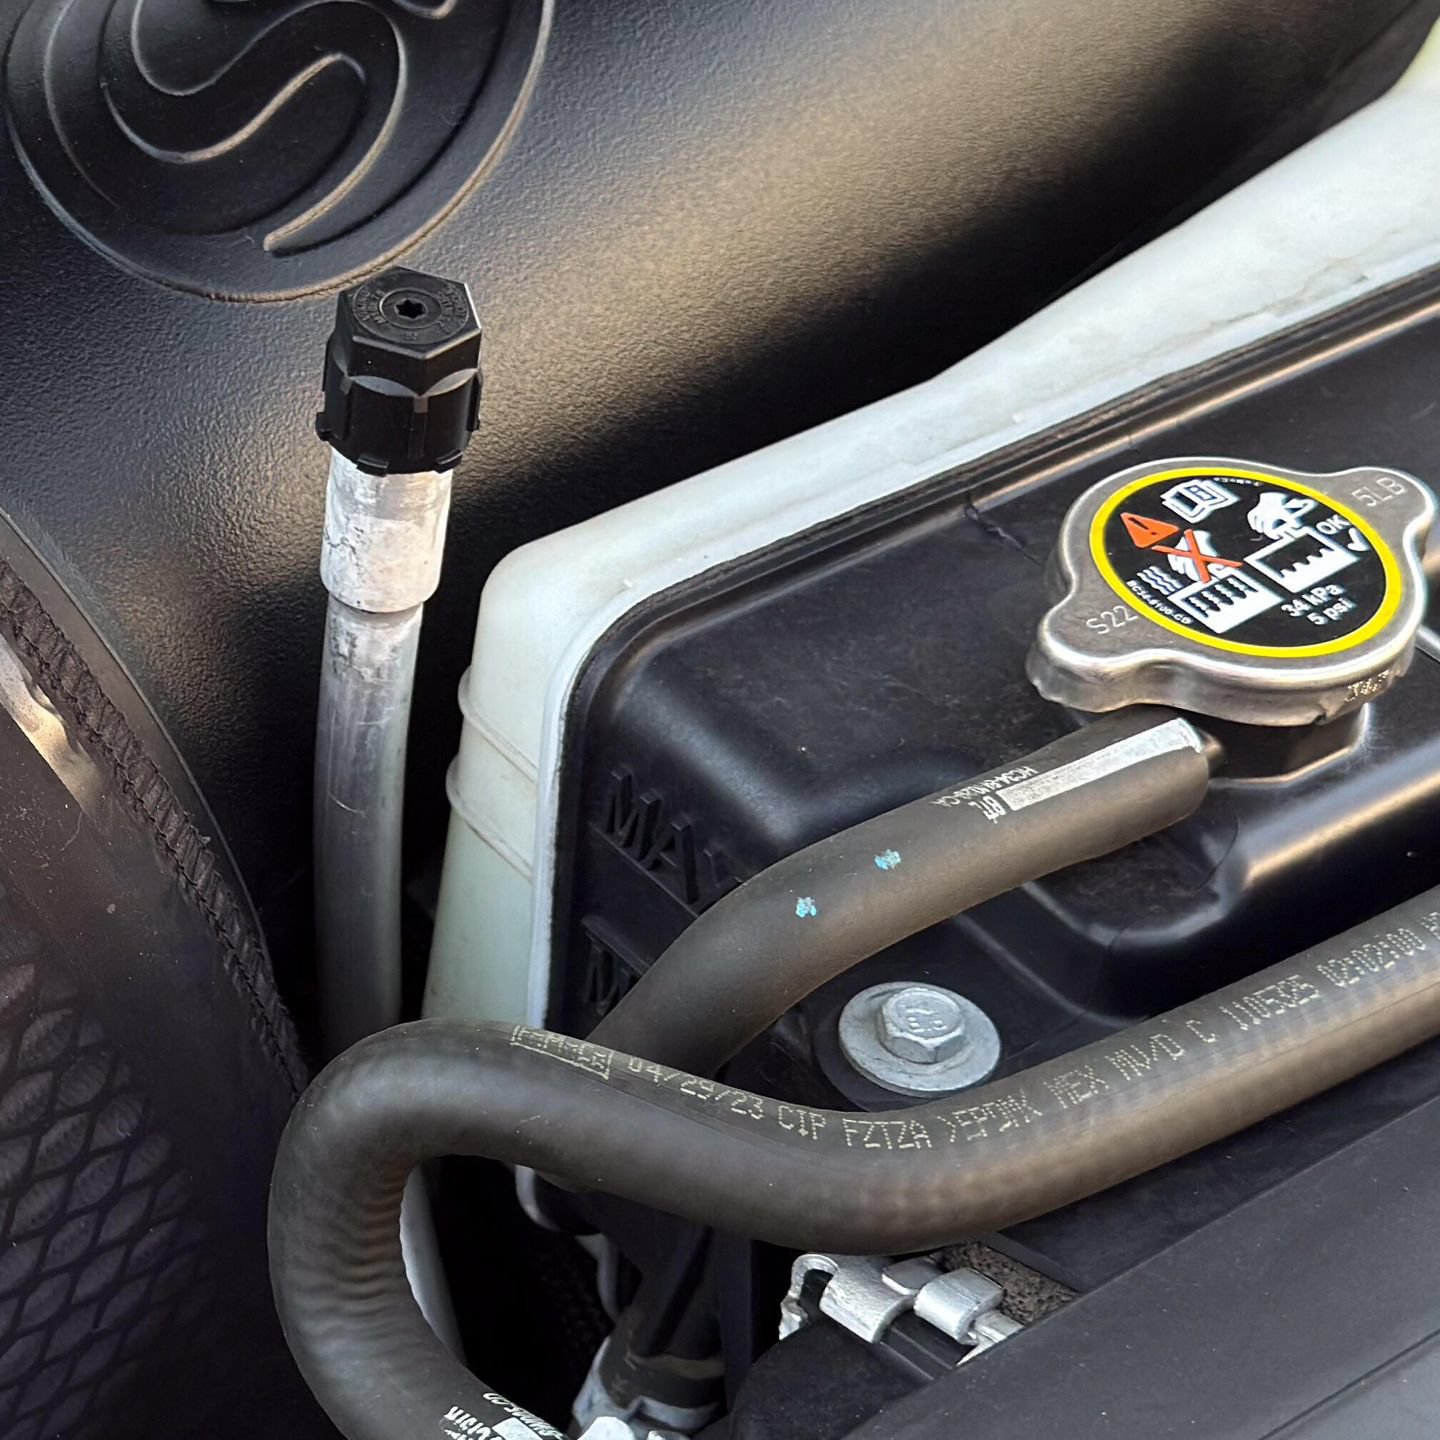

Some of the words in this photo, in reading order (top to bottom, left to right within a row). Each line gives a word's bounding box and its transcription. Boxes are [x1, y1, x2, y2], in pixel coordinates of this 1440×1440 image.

[1352, 477, 1407, 507] 5LB
[1315, 513, 1351, 537] OK
[1280, 596, 1307, 619] 34
[1308, 582, 1347, 606] kPa
[1306, 608, 1326, 626] 5
[1326, 595, 1358, 622] psi
[1085, 604, 1139, 636] S22
